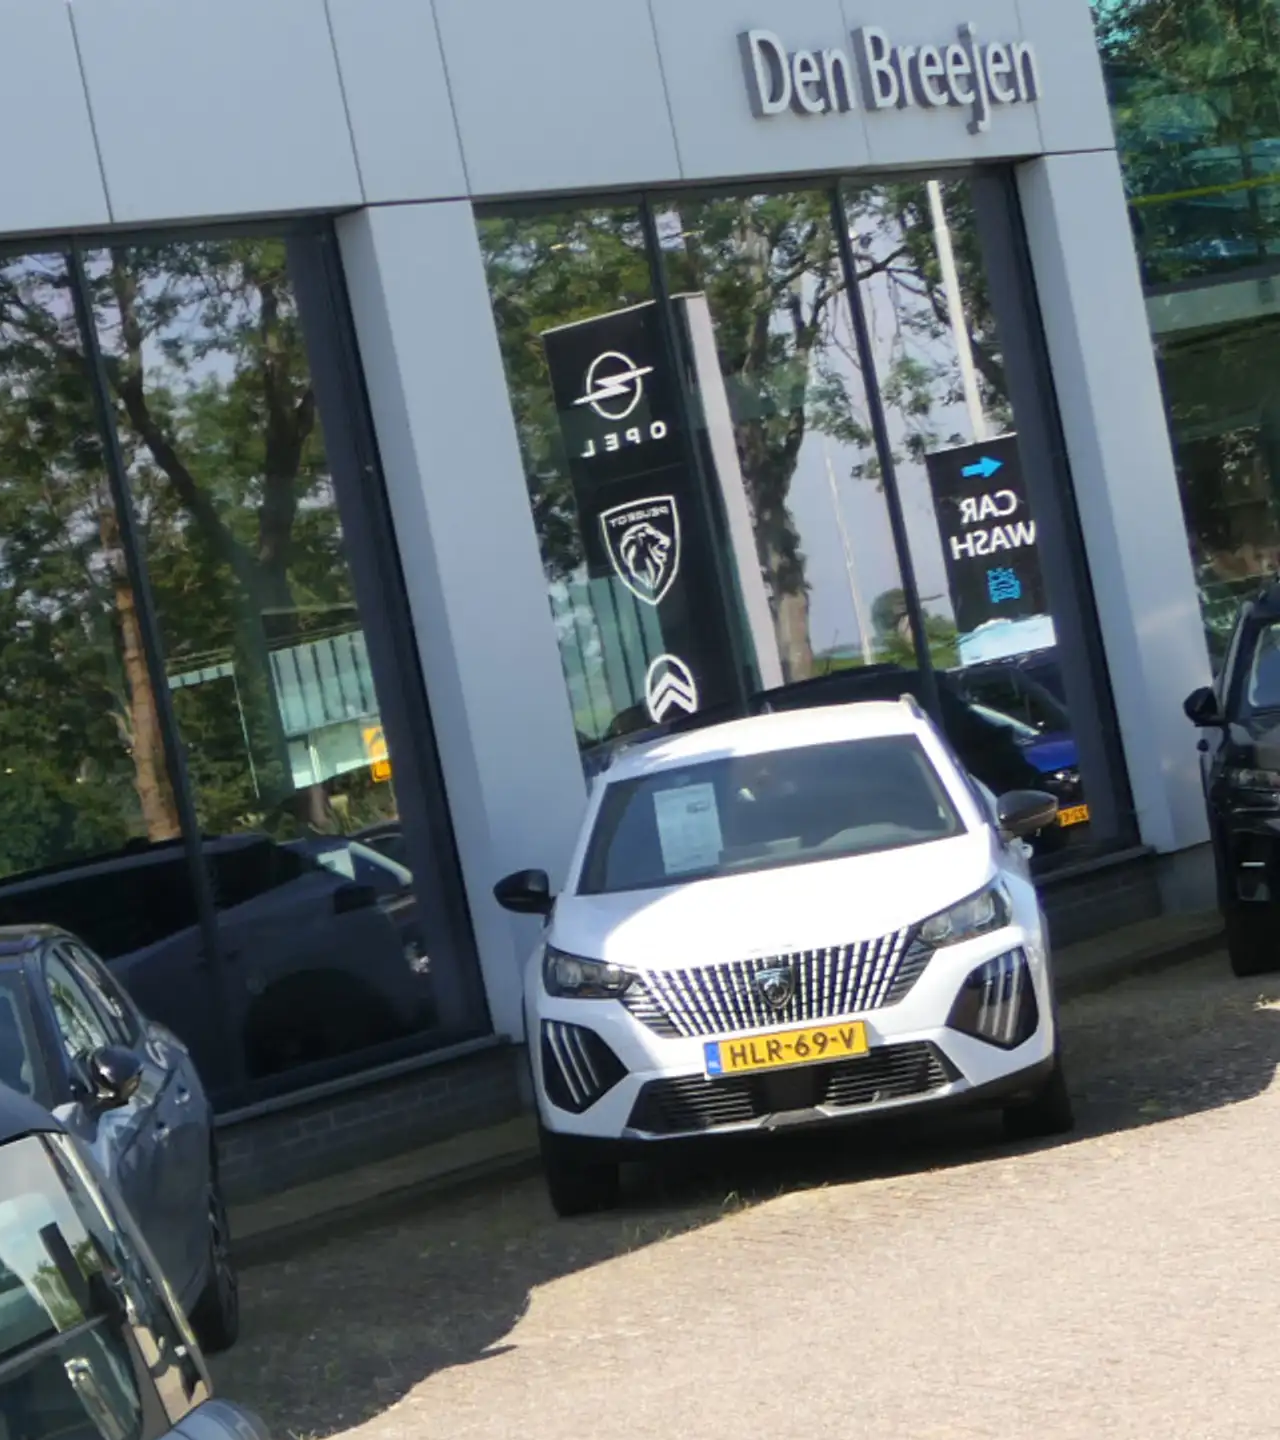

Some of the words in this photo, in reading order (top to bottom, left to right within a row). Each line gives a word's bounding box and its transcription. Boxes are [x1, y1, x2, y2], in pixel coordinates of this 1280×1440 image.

[737, 28, 858, 119] Den
[851, 20, 1043, 136] Breejen
[729, 1027, 856, 1069] HLR-69-V
